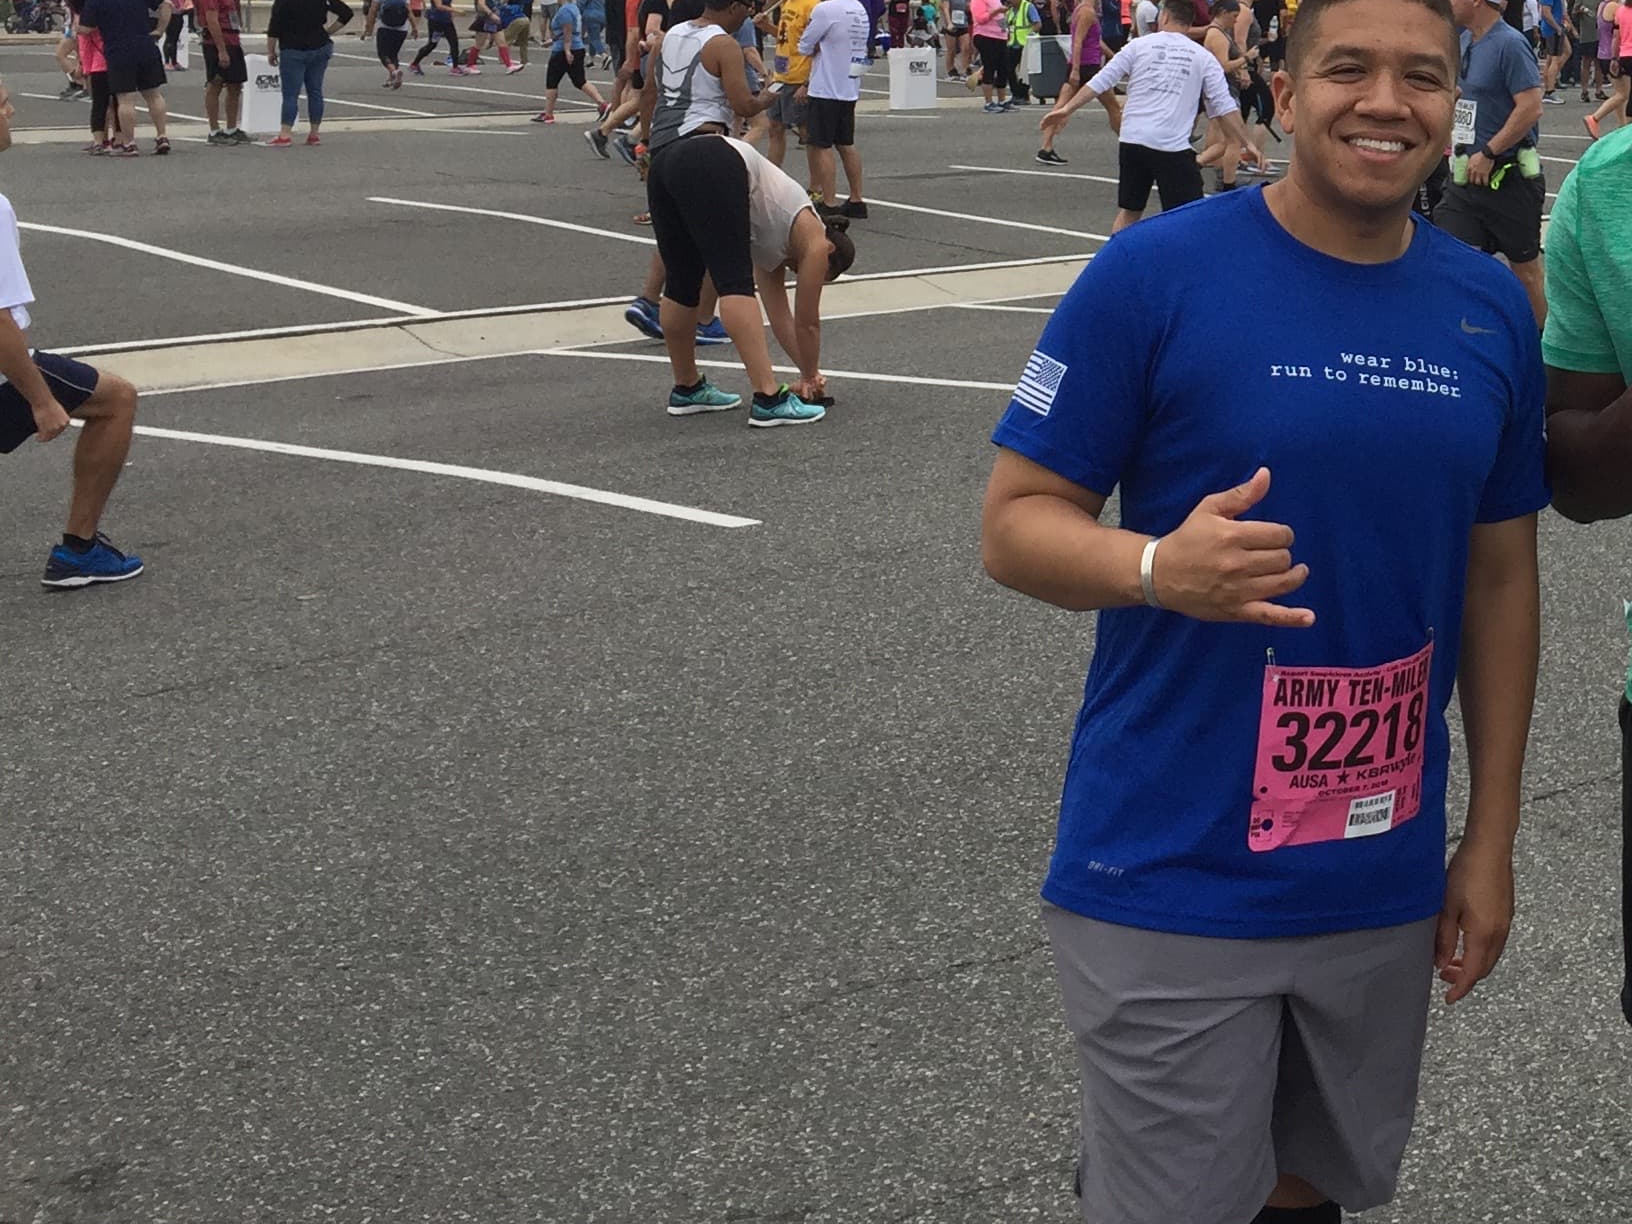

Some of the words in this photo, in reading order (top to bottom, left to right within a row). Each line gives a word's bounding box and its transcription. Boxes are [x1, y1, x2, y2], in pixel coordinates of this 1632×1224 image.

[1270, 364, 1312, 377] run
[1324, 366, 1347, 381] to
[1359, 373, 1462, 398] remember
[1340, 352, 1391, 368] wear
[1404, 357, 1459, 380] blue:
[1273, 678, 1340, 707] ARMY
[1348, 657, 1430, 706] TEN-MILER
[1272, 691, 1424, 772] 32218
[1289, 774, 1329, 789] AUSA
[1318, 785, 1361, 797] OCTOBER
